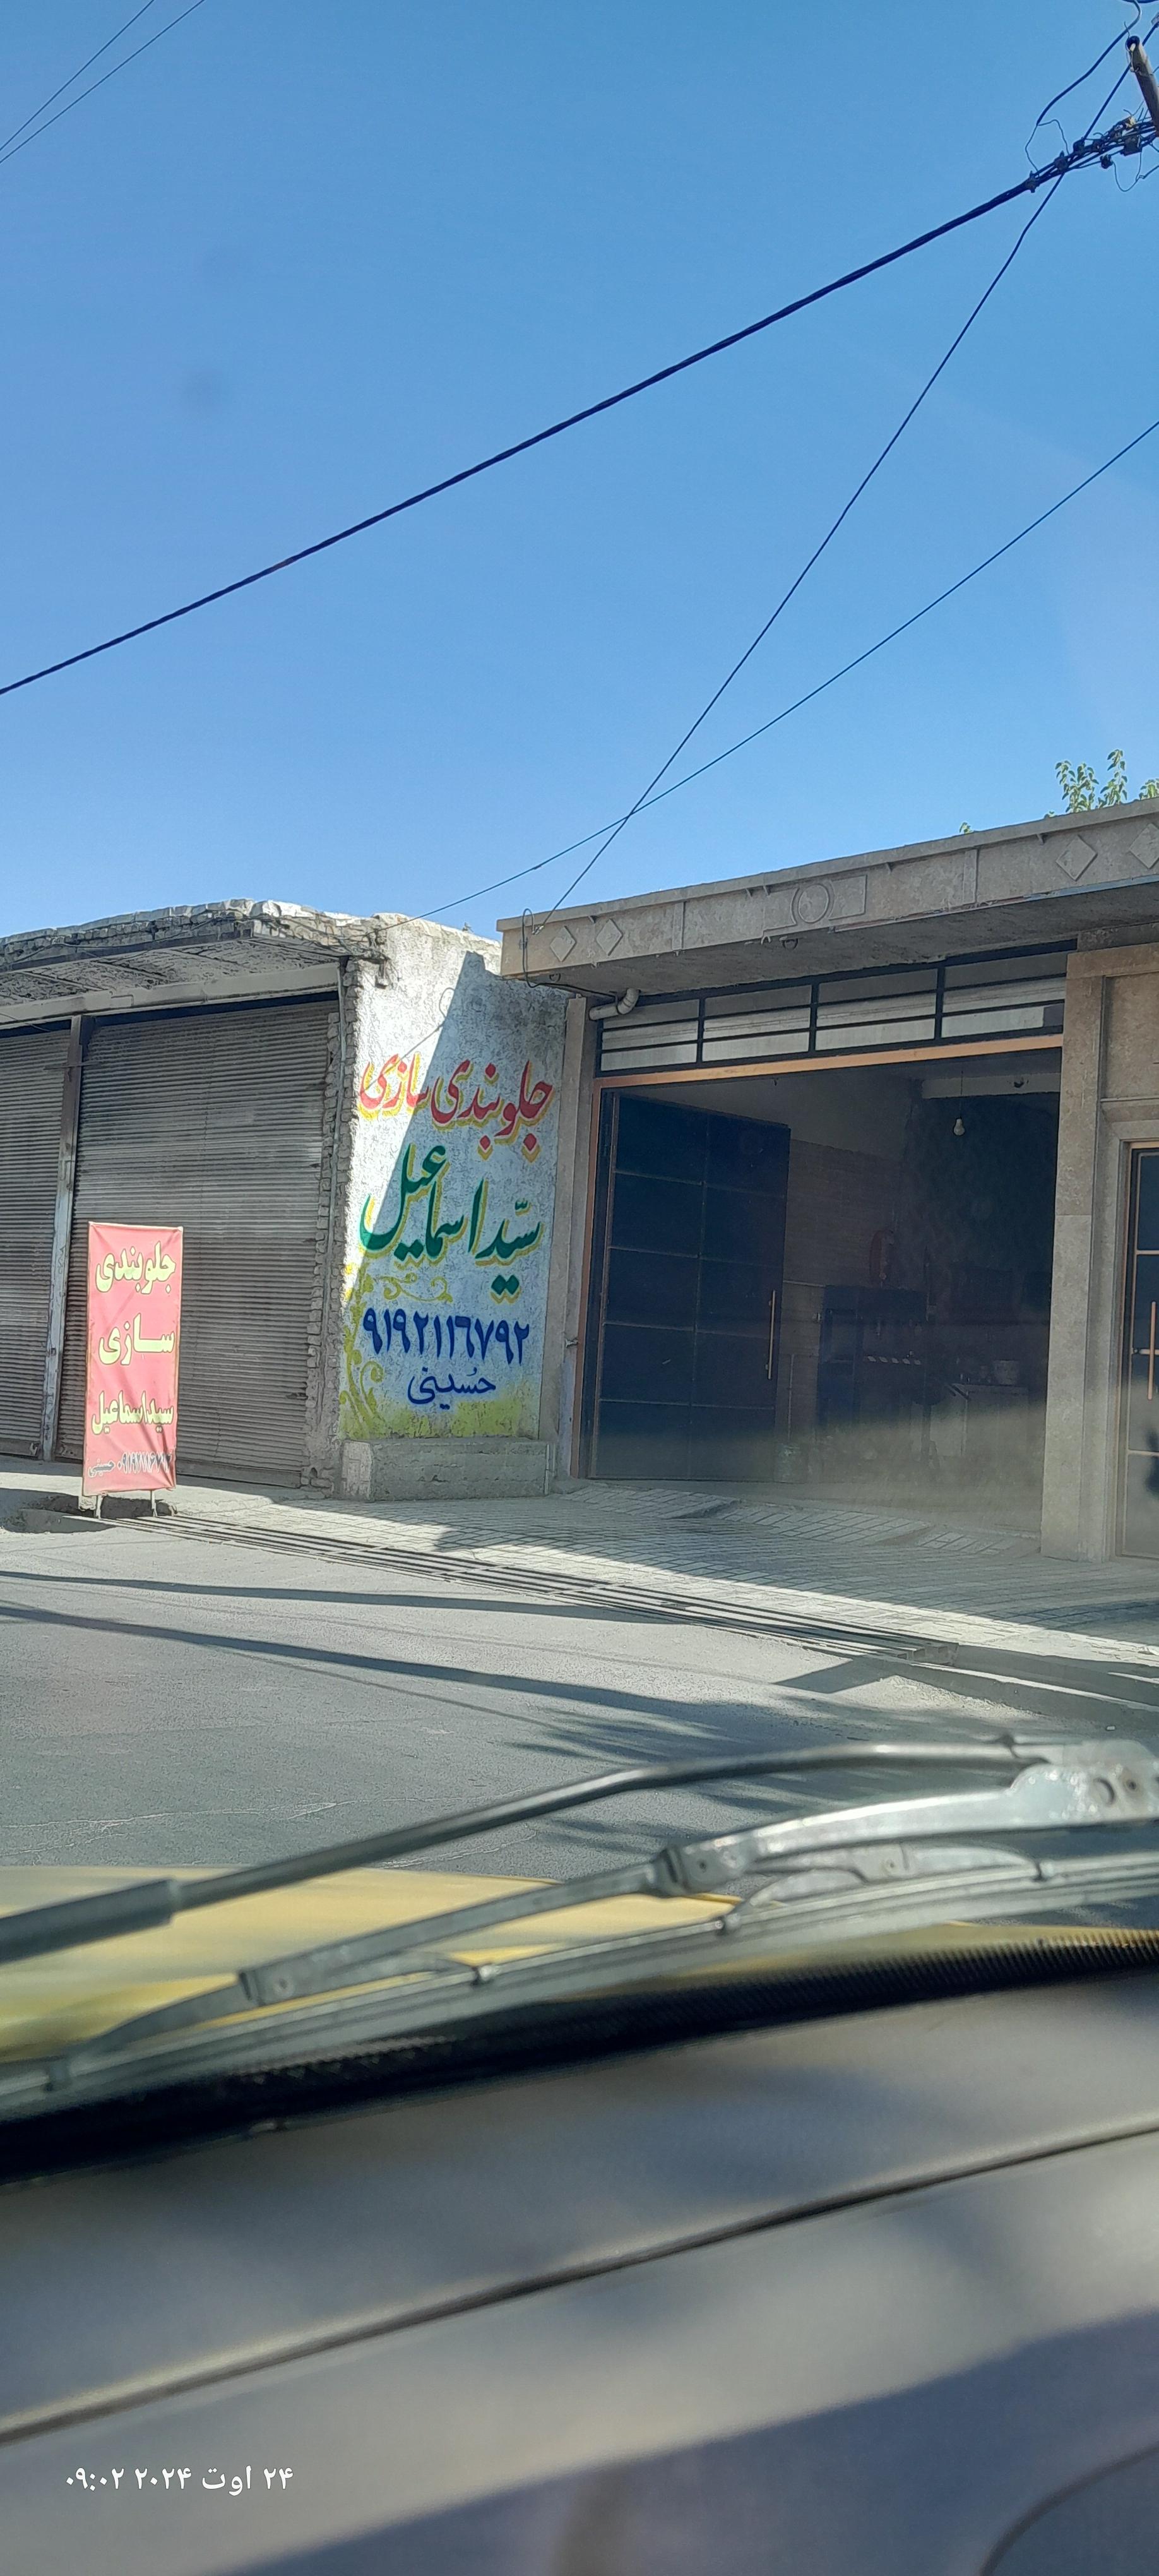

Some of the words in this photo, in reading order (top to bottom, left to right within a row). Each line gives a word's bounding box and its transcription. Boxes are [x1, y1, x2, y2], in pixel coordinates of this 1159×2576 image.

[359, 1052, 431, 1111] سازی
[431, 1059, 554, 1152] جلوبندی
[360, 1143, 484, 1261] اسماعیل
[95, 1241, 176, 1295] جلوبندی
[99, 1313, 175, 1365] سازی
